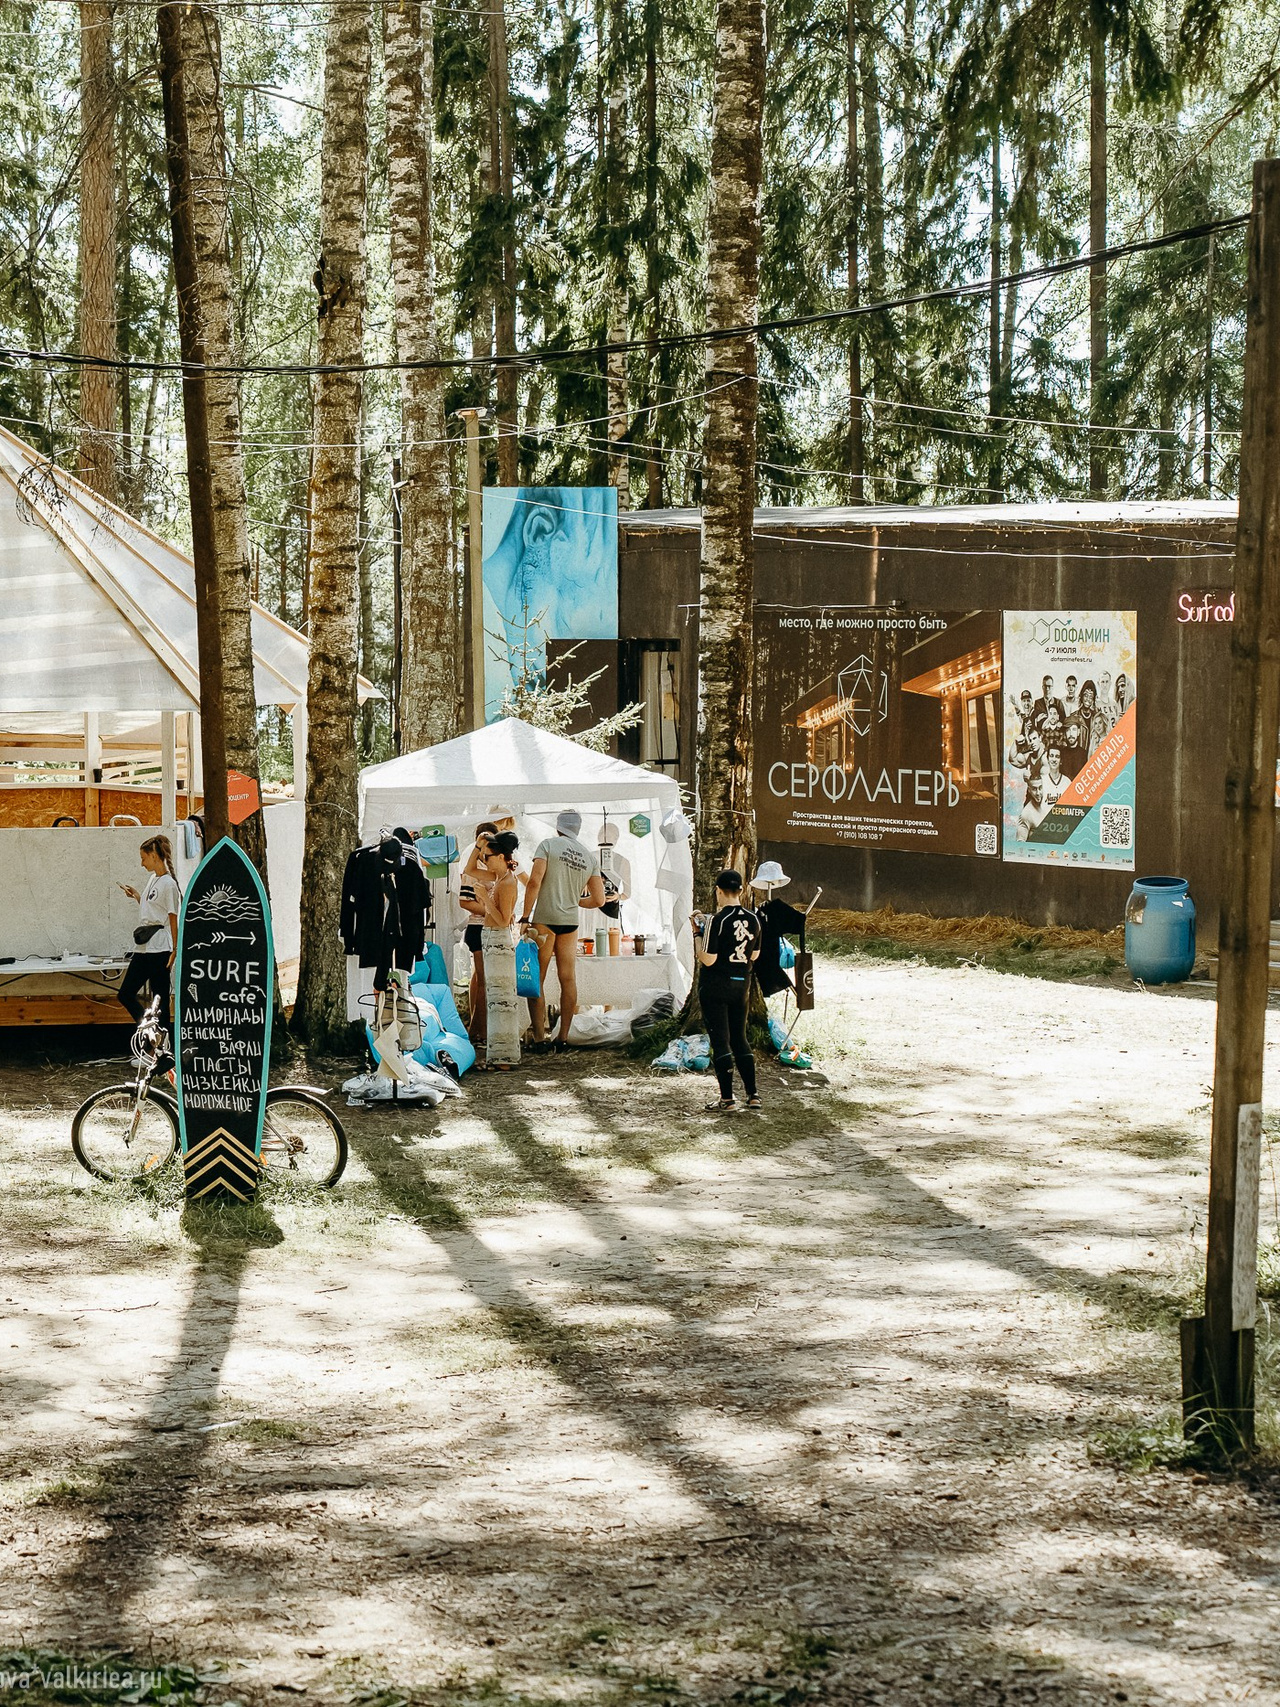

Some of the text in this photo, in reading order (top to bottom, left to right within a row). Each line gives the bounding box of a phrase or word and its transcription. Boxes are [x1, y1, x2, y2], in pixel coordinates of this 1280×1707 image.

[1177, 593, 1213, 622] Surf
[779, 616, 948, 632] место, где можно просто быть
[1075, 734, 1124, 795] ФЕСТИВАЛЬ
[1082, 795, 1090, 803] НА
[1116, 743, 1130, 760] МОРЕ
[768, 761, 960, 808] СЕРФЛАГЕРЬ
[792, 811, 934, 828] Пространства для ваших тематических проектов,
[831, 821, 851, 830] сессий
[857, 824, 878, 832] просто
[878, 826, 917, 835] прекрасного
[917, 828, 939, 836] отдыха
[1042, 822, 1070, 833] 2024
[190, 959, 260, 984] SURF
[219, 987, 257, 1005] cafe
[184, 1006, 264, 1025] ЛИМОНАДЫ
[181, 1027, 233, 1041] ВЕНСКИЕ
[219, 1040, 262, 1056] ВАФЛИ
[194, 1057, 252, 1075] ПАСТЫ
[182, 1074, 262, 1094] ЧИЗКЕЙКИ
[184, 1093, 253, 1112] МОРОЖЕНОЕ
